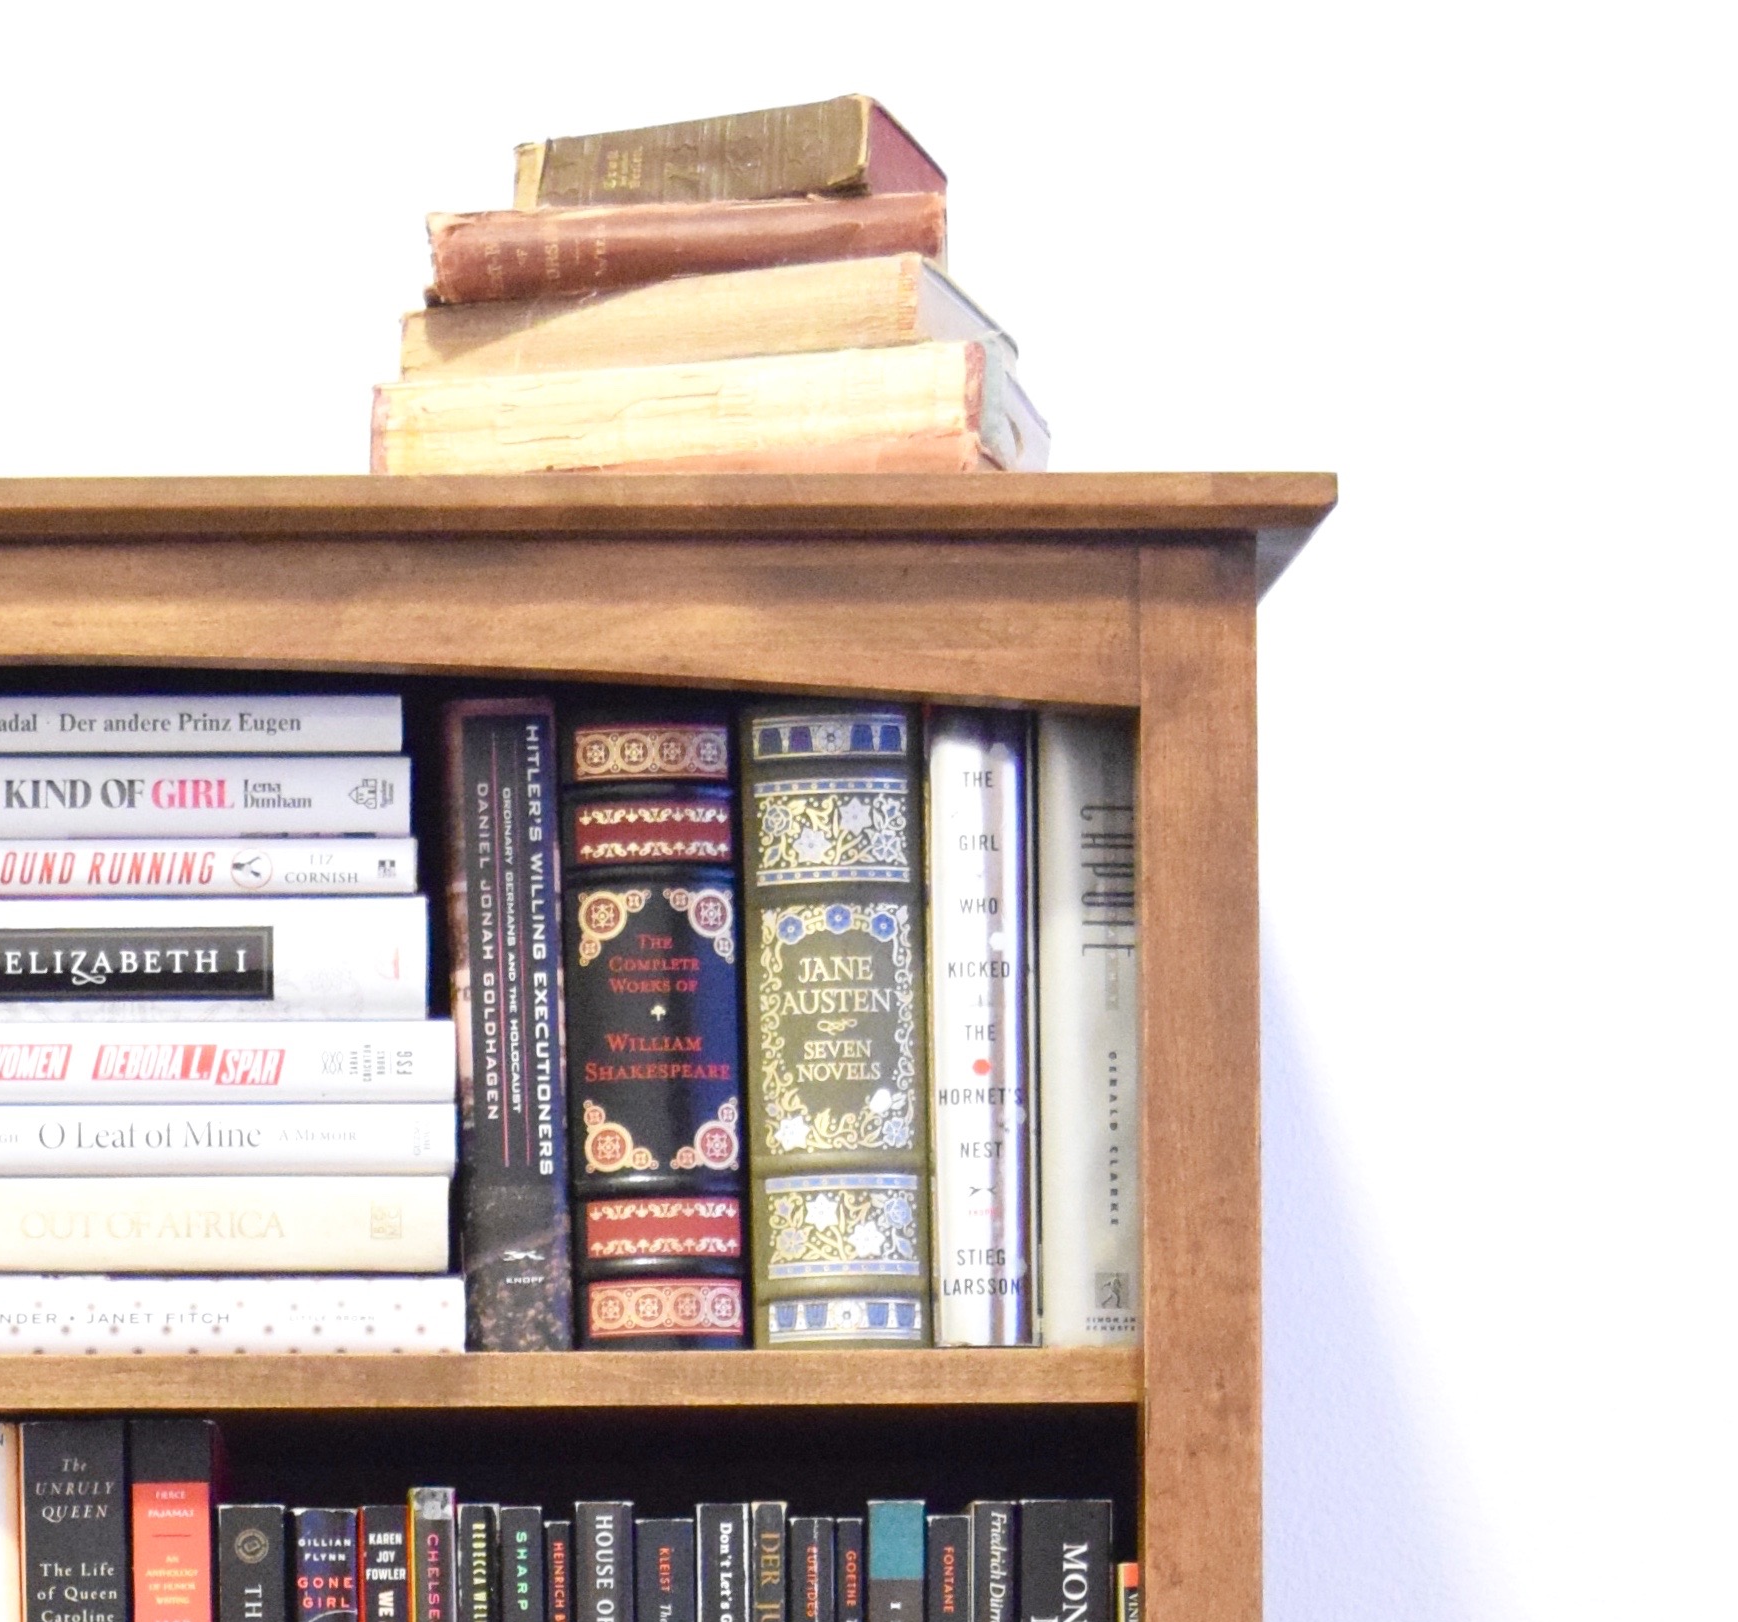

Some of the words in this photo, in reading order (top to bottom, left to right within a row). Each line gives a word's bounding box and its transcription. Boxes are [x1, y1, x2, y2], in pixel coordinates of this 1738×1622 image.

[59, 714, 95, 733] Der
[103, 713, 172, 733] andere
[178, 713, 231, 732] Prinz
[238, 714, 301, 737] Eugen
[3, 780, 92, 810] KIND
[100, 780, 144, 810] OF
[151, 778, 234, 809] GIRL
[88, 852, 216, 885] RUNNING
[6, 950, 218, 985] ELIZABETH
[236, 950, 248, 972] I
[799, 956, 873, 983] JANE
[782, 988, 891, 1015] AUSTEN
[803, 1039, 871, 1060] SEVEN
[796, 1061, 881, 1083] NOVELS
